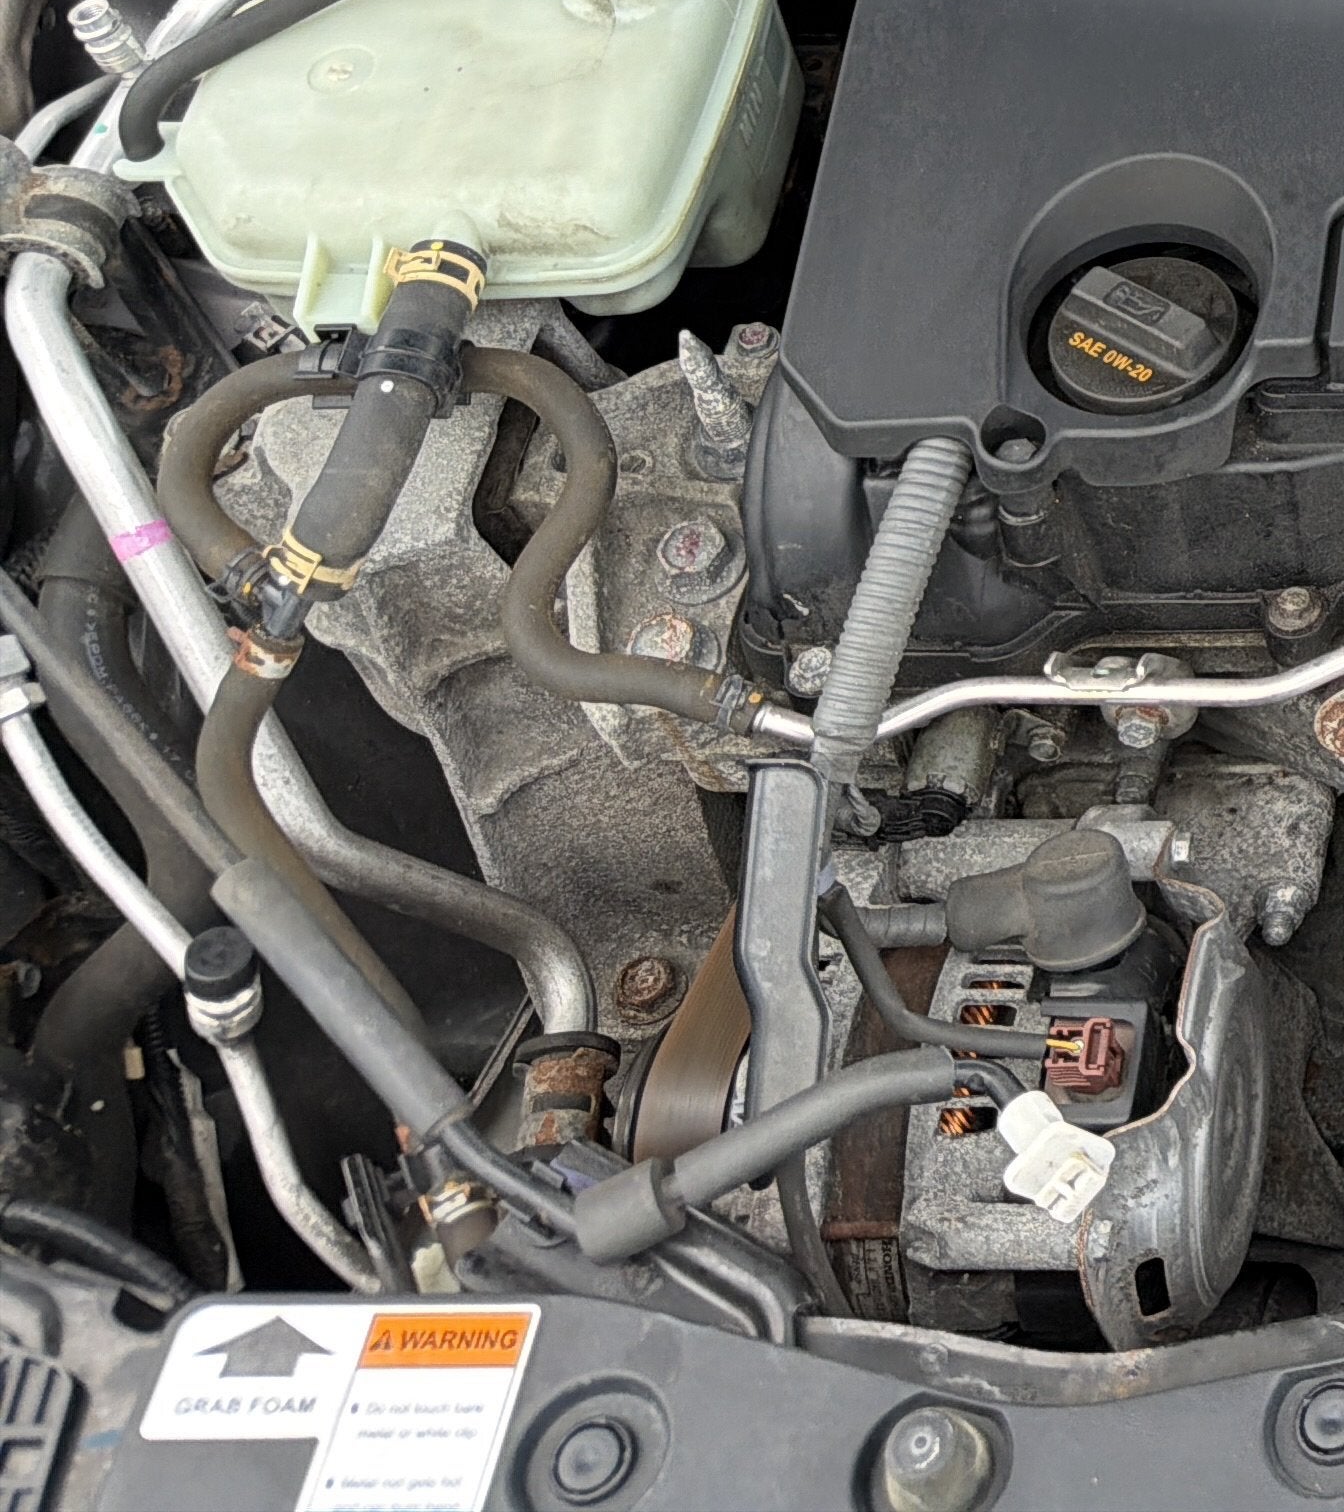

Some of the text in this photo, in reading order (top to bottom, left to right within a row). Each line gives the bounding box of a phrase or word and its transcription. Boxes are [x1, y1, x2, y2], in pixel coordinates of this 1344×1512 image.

[1068, 332, 1153, 382] SAE 0W-20
[399, 1330, 519, 1350] WARNING
[174, 1397, 317, 1415] GRAB FOAM
